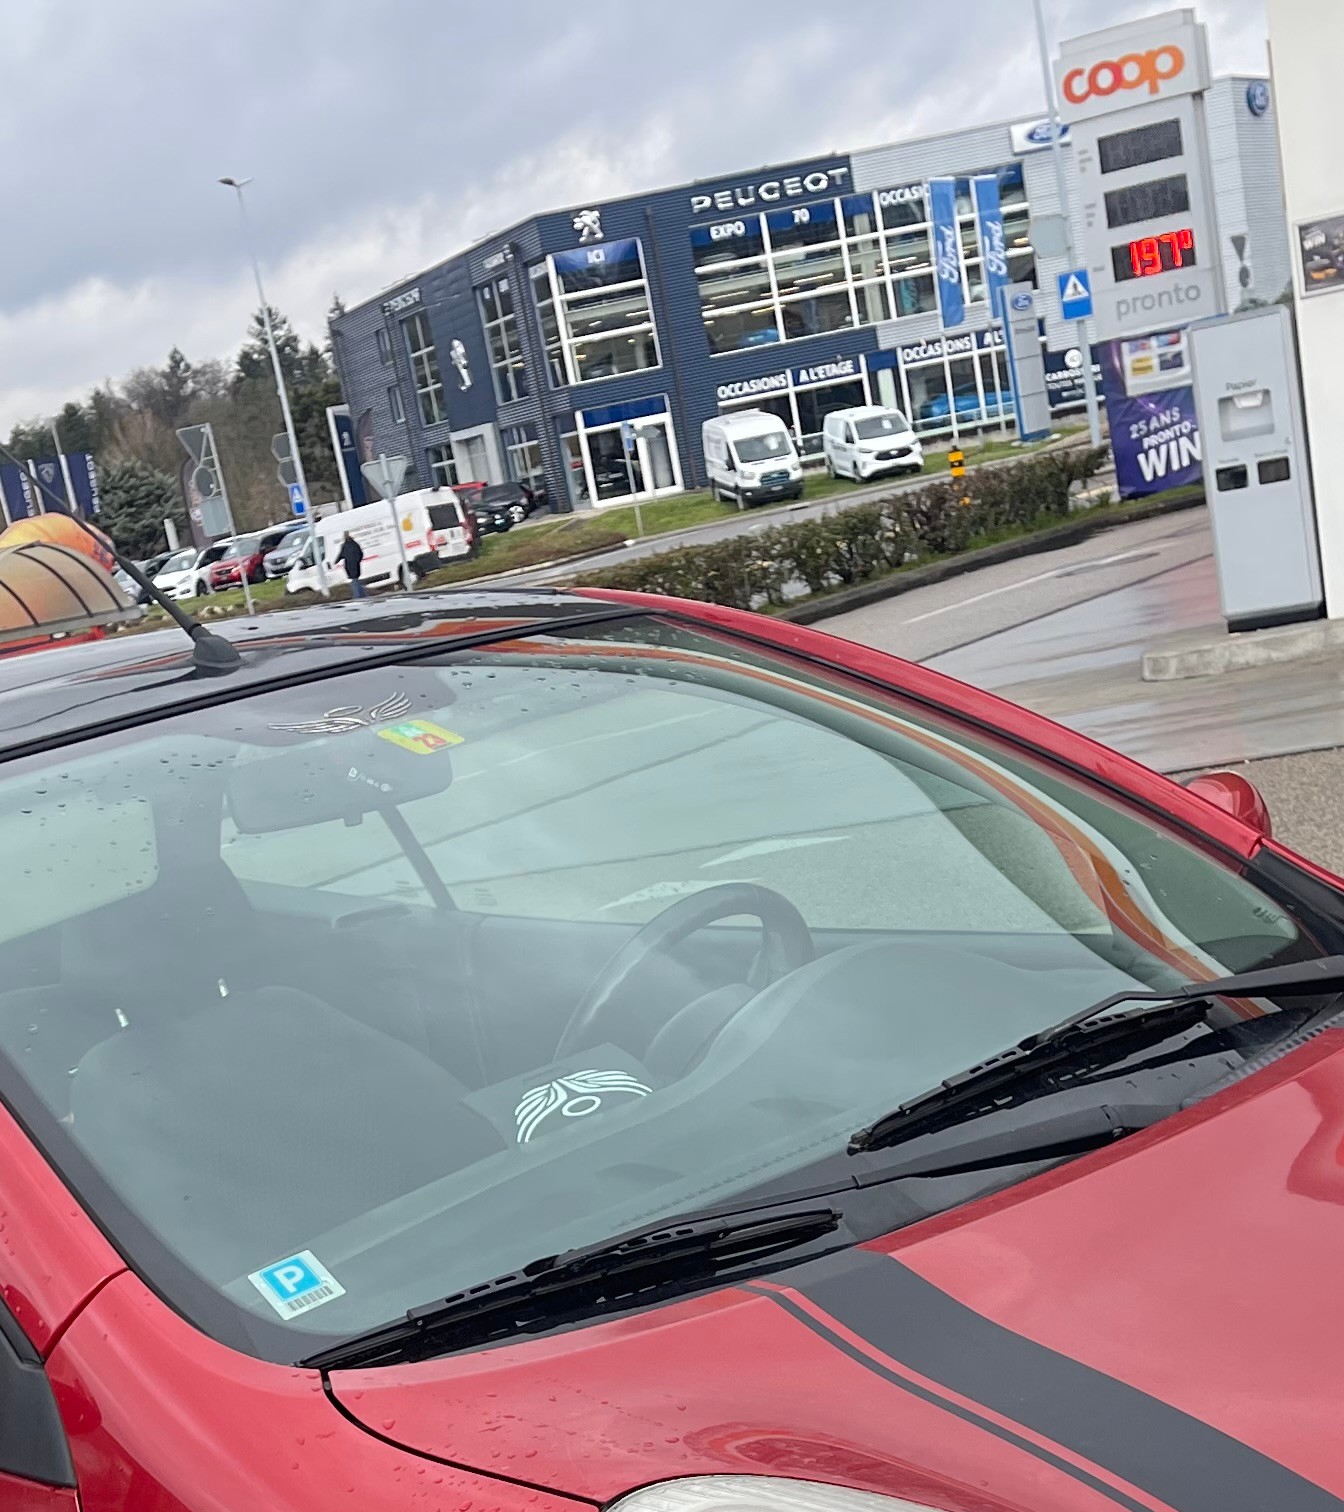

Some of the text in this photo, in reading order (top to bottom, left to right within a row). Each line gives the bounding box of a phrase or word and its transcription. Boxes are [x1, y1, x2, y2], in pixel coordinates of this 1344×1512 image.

[1062, 45, 1185, 104] coop
[690, 167, 848, 213] PEUGEOT
[880, 183, 931, 208] OCCASIO
[709, 220, 746, 241] EXPO
[791, 209, 811, 224] 70
[937, 225, 959, 283] Ford
[984, 220, 1007, 276] Ford
[1115, 282, 1202, 321] pronto
[903, 336, 971, 361] OCCASONS
[717, 372, 788, 399] OCCASIONS
[1129, 406, 1181, 439] 25 ANS
[1136, 430, 1202, 483] WIN
[272, 1265, 305, 1294] P
